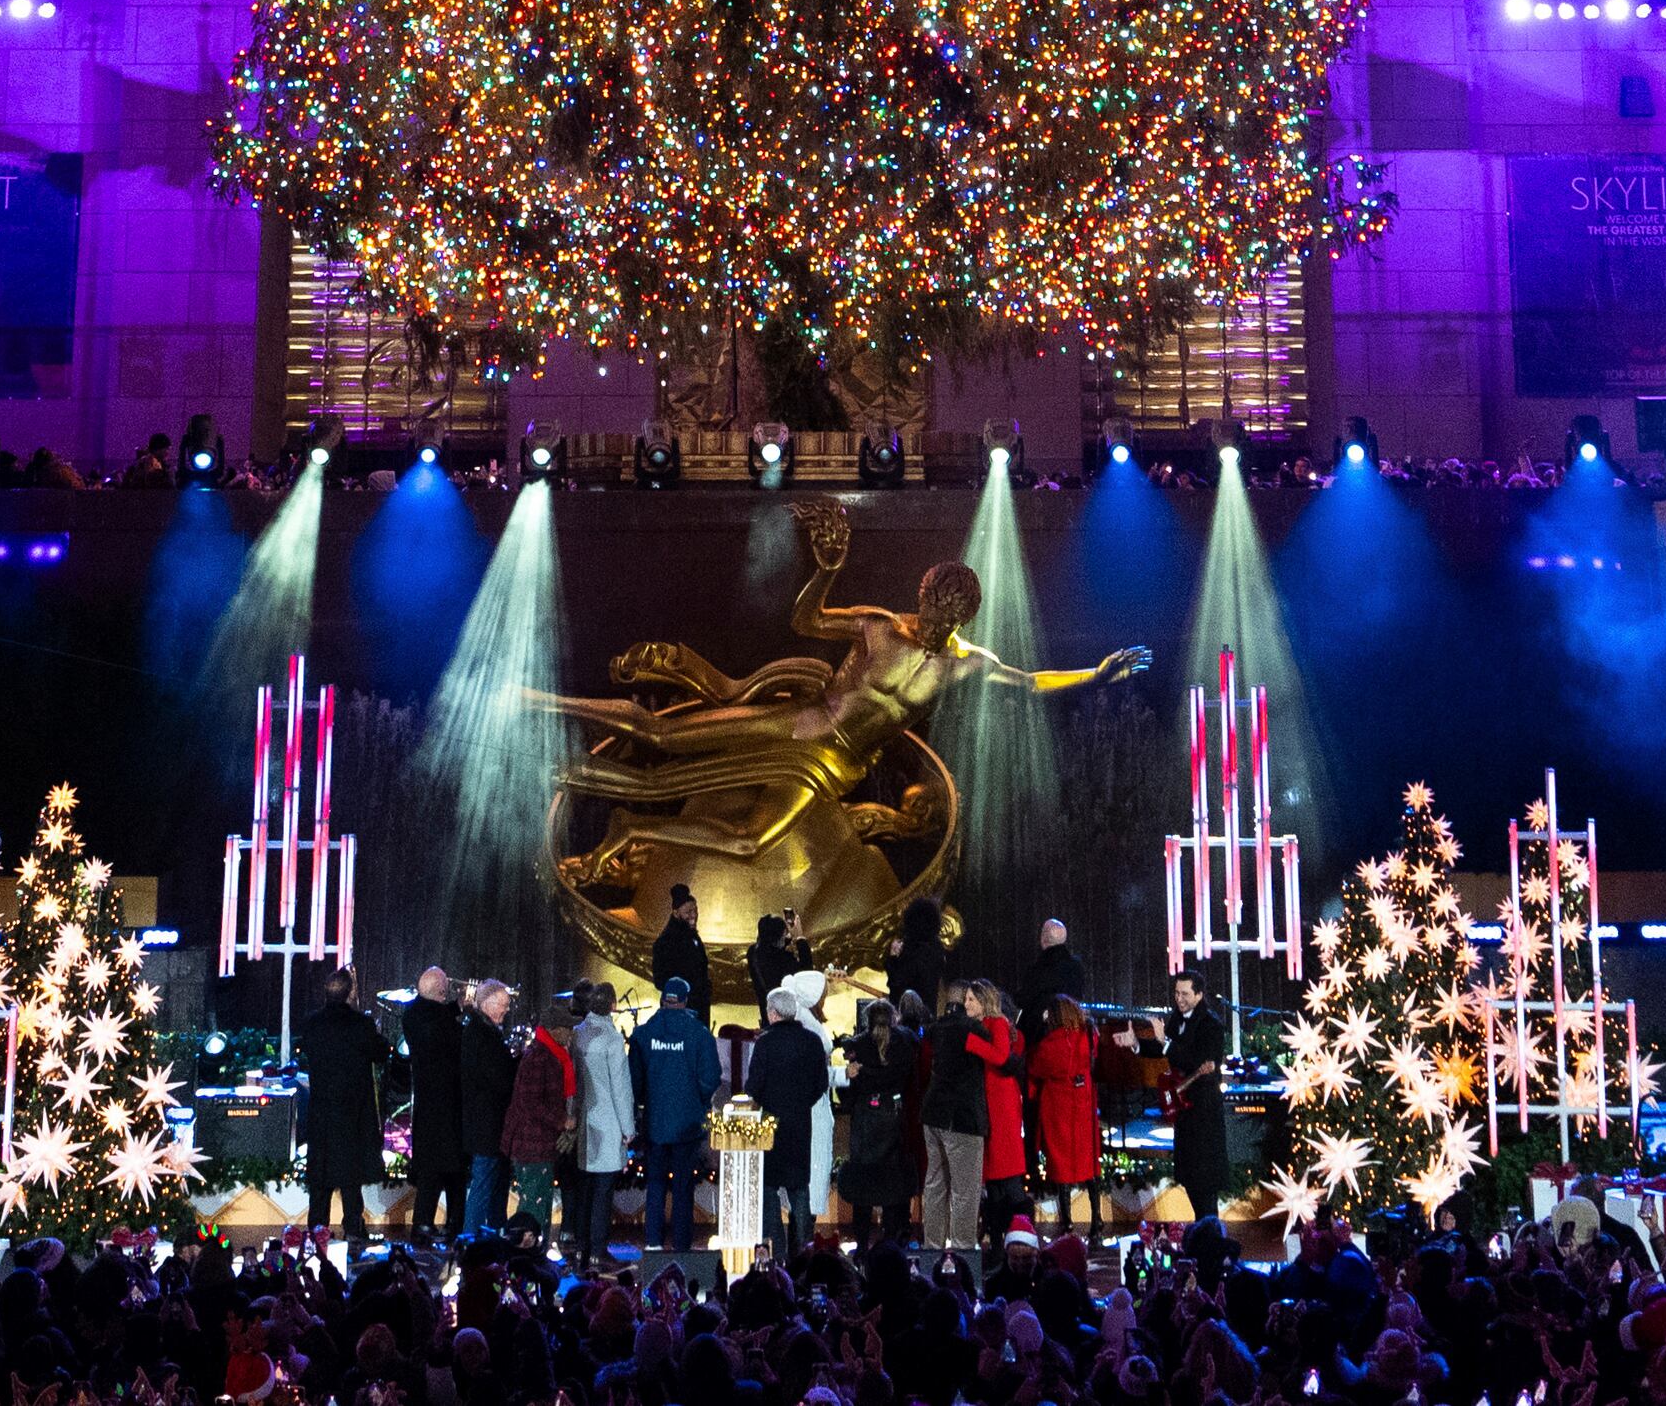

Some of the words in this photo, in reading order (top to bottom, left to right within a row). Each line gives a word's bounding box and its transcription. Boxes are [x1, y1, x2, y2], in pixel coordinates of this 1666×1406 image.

[1605, 214, 1659, 224] WELCOME
[1587, 225, 1608, 235] THE
[1610, 225, 1664, 235] GREATEST
[1604, 236, 1615, 246] IN
[1618, 236, 1638, 246] THE
